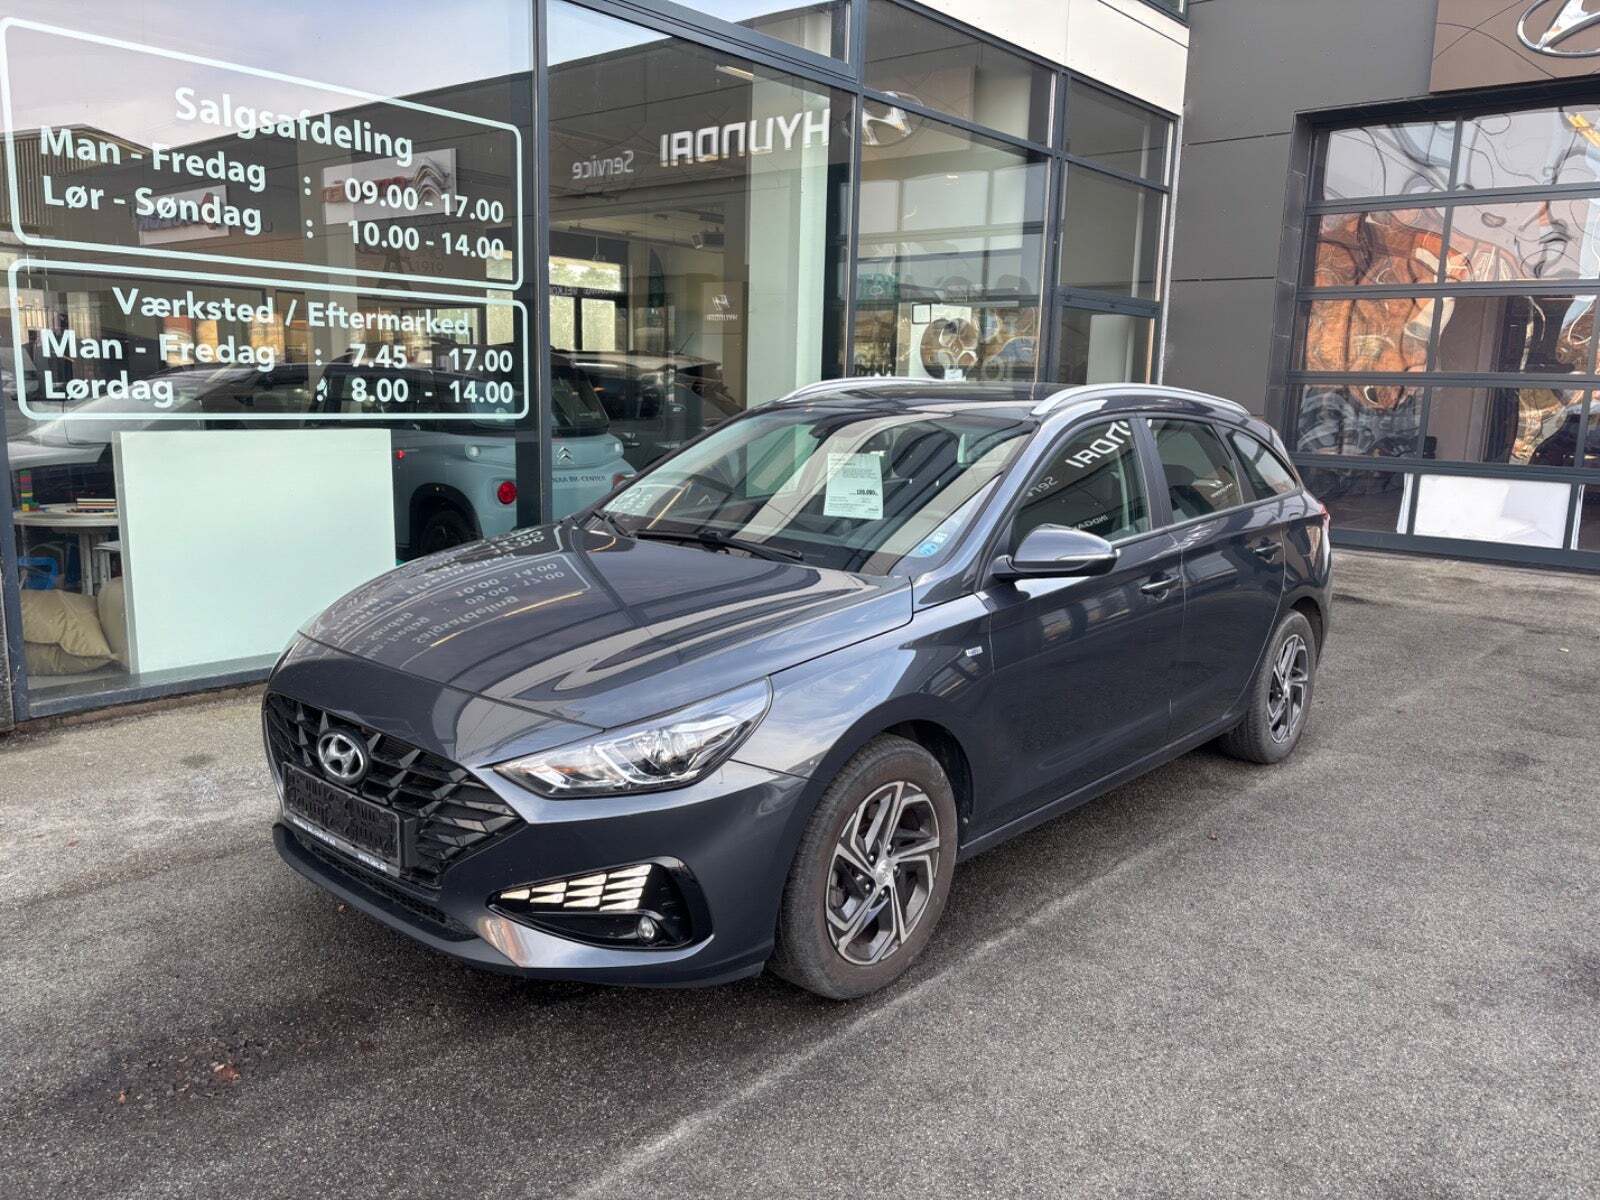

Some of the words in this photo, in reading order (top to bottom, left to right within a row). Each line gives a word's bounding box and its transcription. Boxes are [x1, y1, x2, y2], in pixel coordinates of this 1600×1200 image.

[174, 87, 413, 168] Salgsafdeling
[39, 125, 121, 166] Man
[152, 143, 266, 193] Fredag
[344, 177, 419, 211] 09.00
[440, 192, 505, 224] 17.00
[43, 175, 105, 212] Lør
[135, 187, 262, 236] Søndag
[347, 219, 420, 251] 10.00
[441, 231, 505, 261] 14.00
[111, 286, 274, 323] Værksted
[308, 301, 470, 335] Eftermarked
[41, 328, 123, 359] Man
[159, 334, 276, 373] Fredag
[350, 343, 408, 369] 7.45
[448, 348, 514, 373] 17.00
[44, 370, 174, 409] Lørdag
[351, 378, 409, 403] 8.00
[449, 379, 514, 404] 14.00
